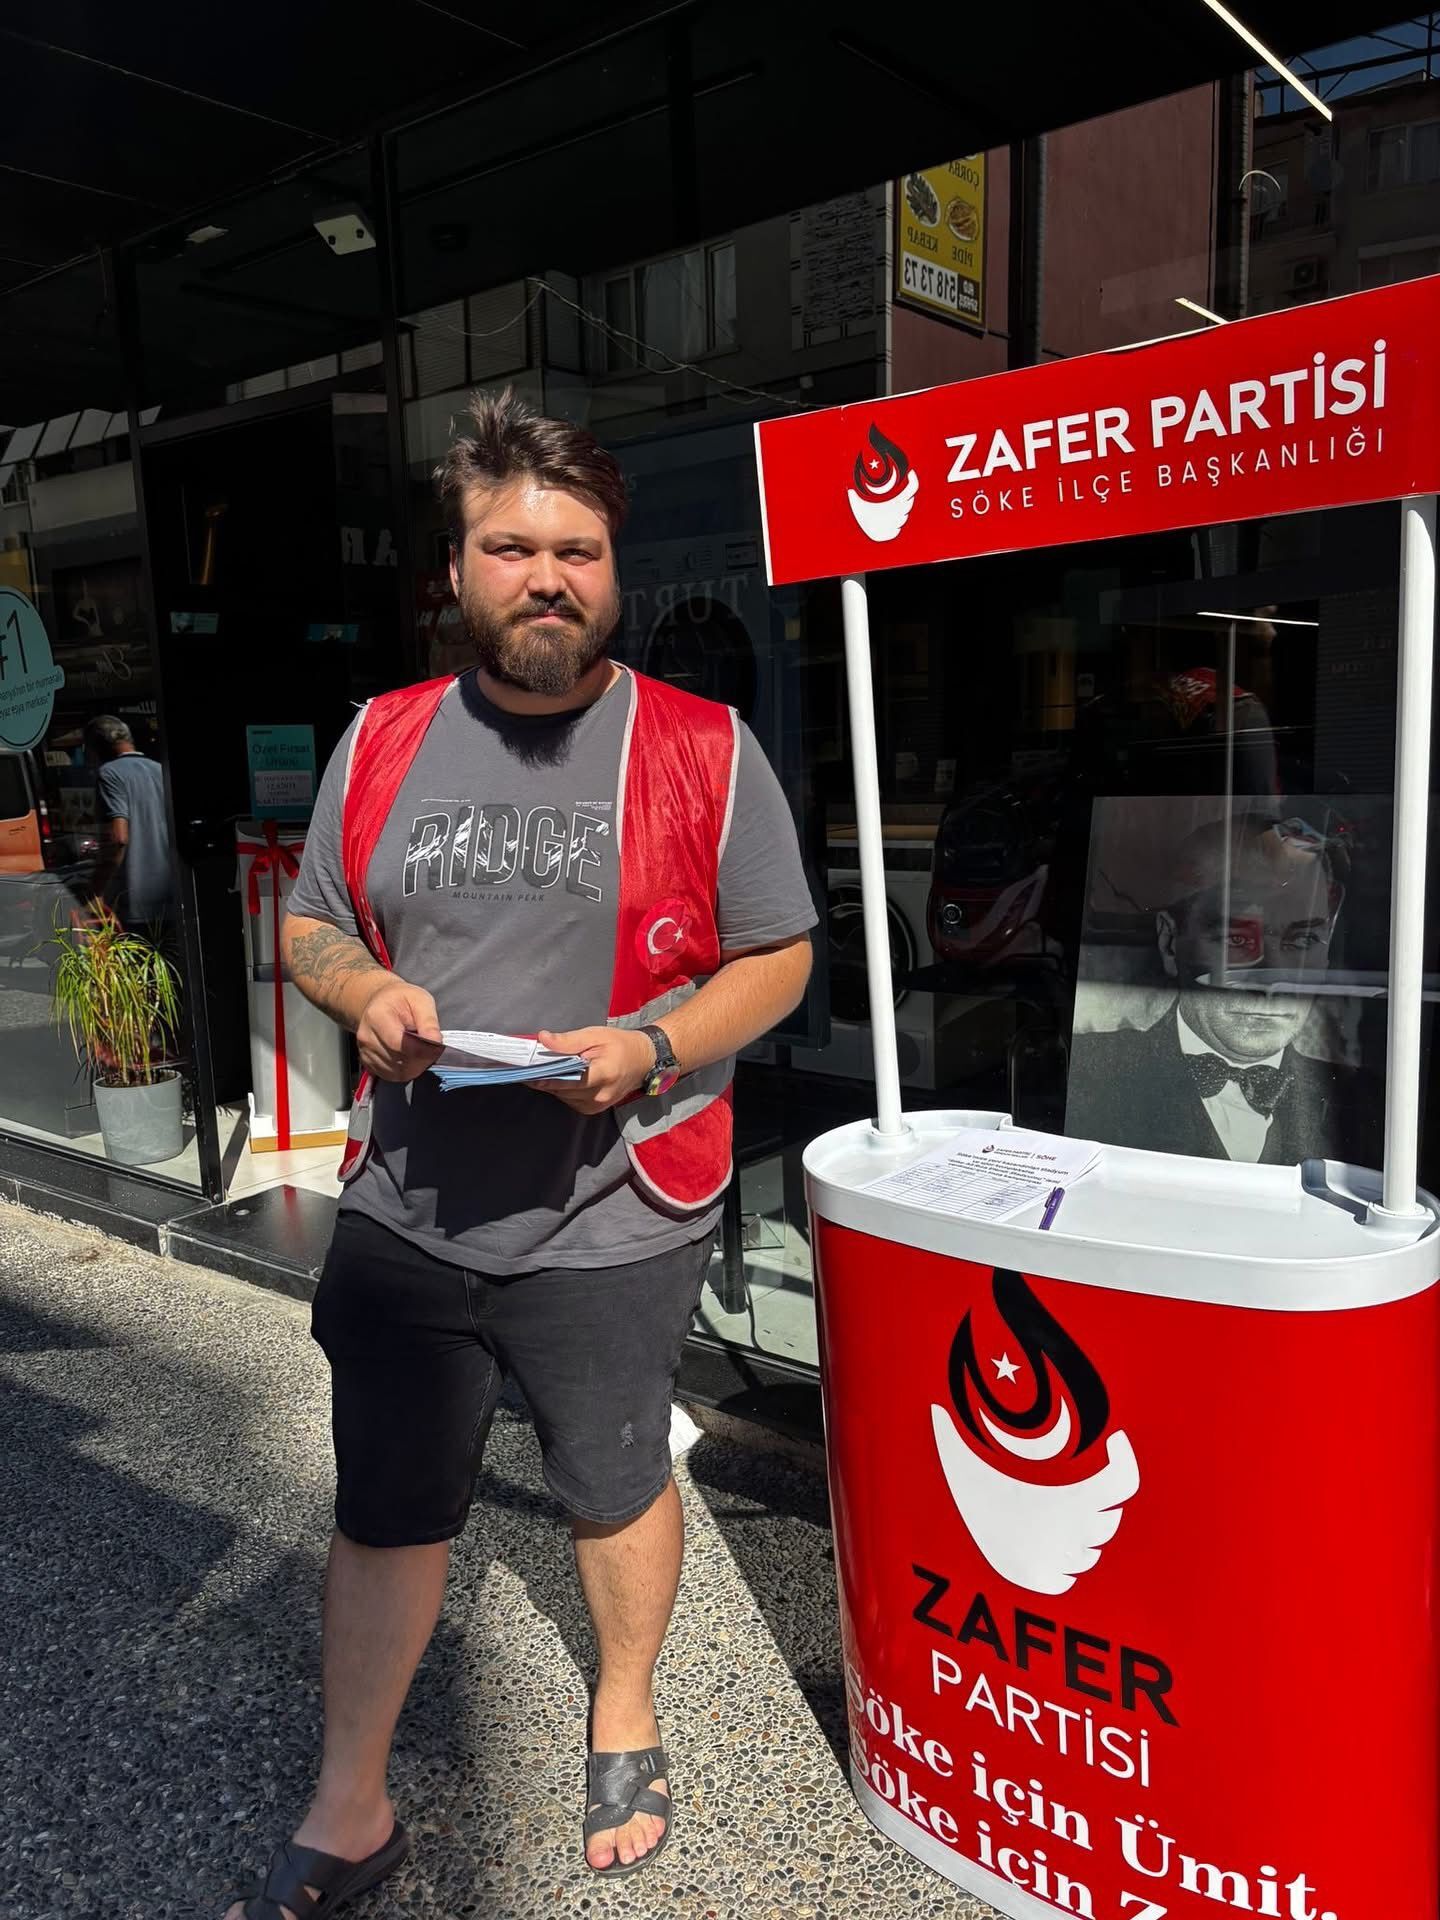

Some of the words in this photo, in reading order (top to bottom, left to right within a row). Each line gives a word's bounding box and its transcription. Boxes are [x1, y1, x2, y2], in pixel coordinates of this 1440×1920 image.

[944, 406, 1135, 483] ZAFER
[1150, 338, 1387, 448] PARTİSİ
[950, 486, 1034, 519] SÖKE
[1057, 471, 1133, 504] İLÇE
[1158, 426, 1384, 489] BAŞKANLIĞI
[402, 803, 610, 903] RIDGE
[452, 891, 513, 902] MOUNTAIN
[517, 893, 545, 902] PEAK
[911, 1563, 1181, 1728] ZAFER
[847, 1663, 954, 1778] Söke
[971, 1750, 1093, 1852] için
[931, 1648, 1150, 1788] PARTİSİ
[850, 1727, 960, 1844] Söke
[976, 1818, 1097, 1920] için
